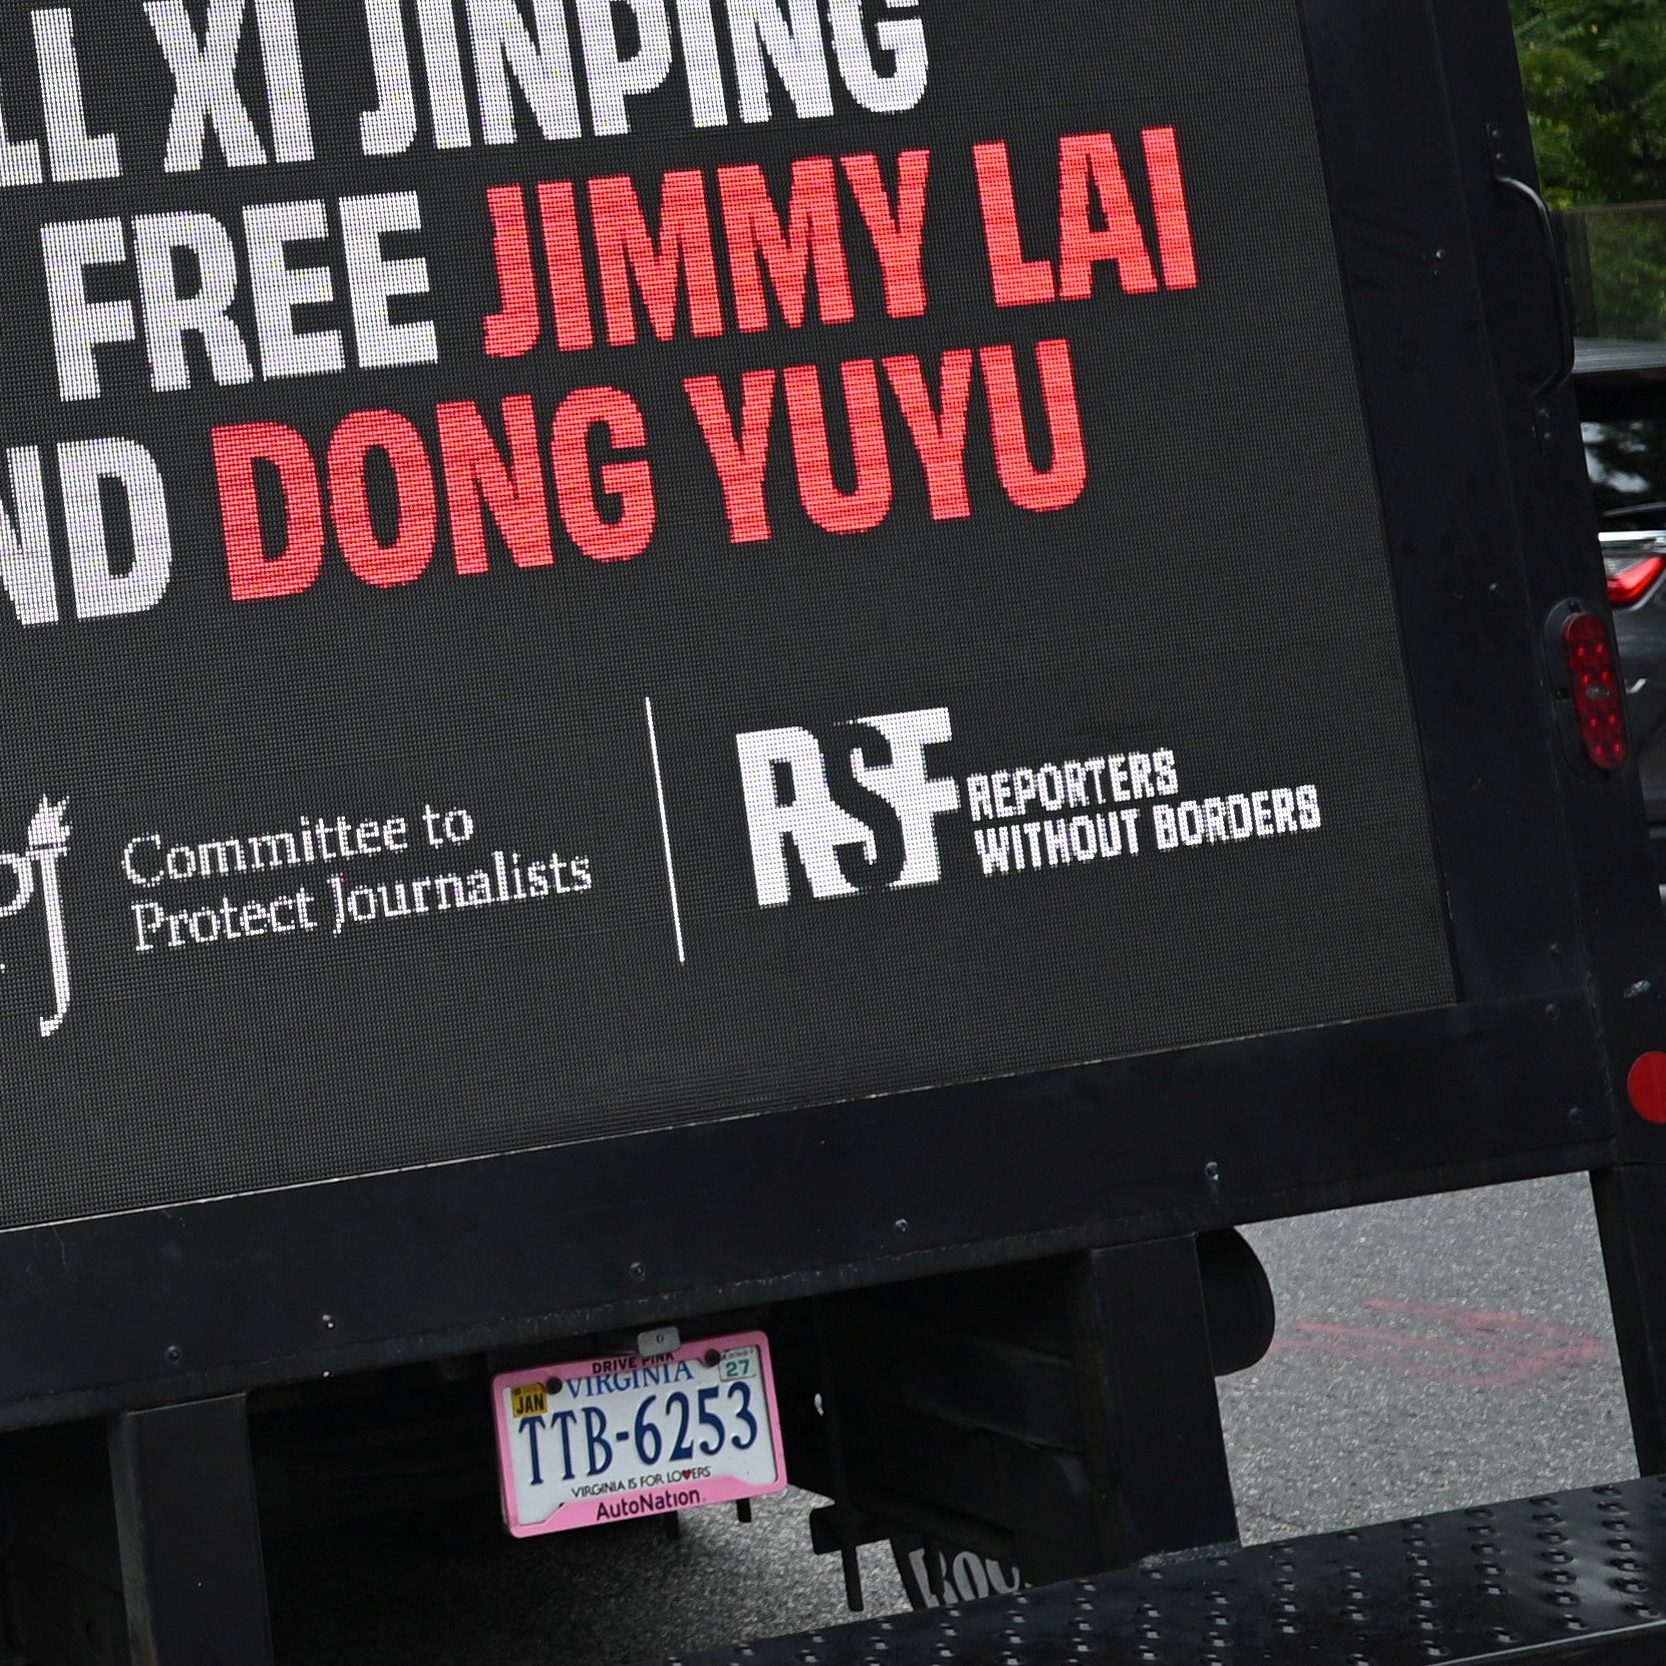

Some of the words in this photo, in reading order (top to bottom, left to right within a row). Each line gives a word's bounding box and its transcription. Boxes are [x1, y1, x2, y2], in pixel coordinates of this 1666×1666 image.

[39, 190, 439, 403] FREE
[482, 147, 933, 360] JIMMY
[972, 126, 1198, 308] LAI
[209, 384, 657, 603] DONG
[682, 337, 1089, 545] YUYU
[734, 706, 961, 910] RSF
[967, 747, 1180, 822] REPORTERS
[120, 813, 408, 888] Committee
[422, 803, 475, 846] to
[973, 807, 1140, 876] WITHOUT
[1152, 782, 1324, 851] BORDERS
[131, 884, 319, 954] Protect
[332, 850, 594, 936] Journalists
[516, 1393, 545, 1414] JAN
[565, 1359, 696, 1400] VIRGINIA
[591, 1356, 638, 1375] DRIVE
[725, 1358, 751, 1378] 27
[517, 1381, 759, 1485] TTB-6253
[571, 1481, 622, 1498] VIRGINIA
[628, 1477, 638, 1490] IS
[640, 1473, 665, 1488] FOR
[595, 1488, 702, 1522] AutoNation
